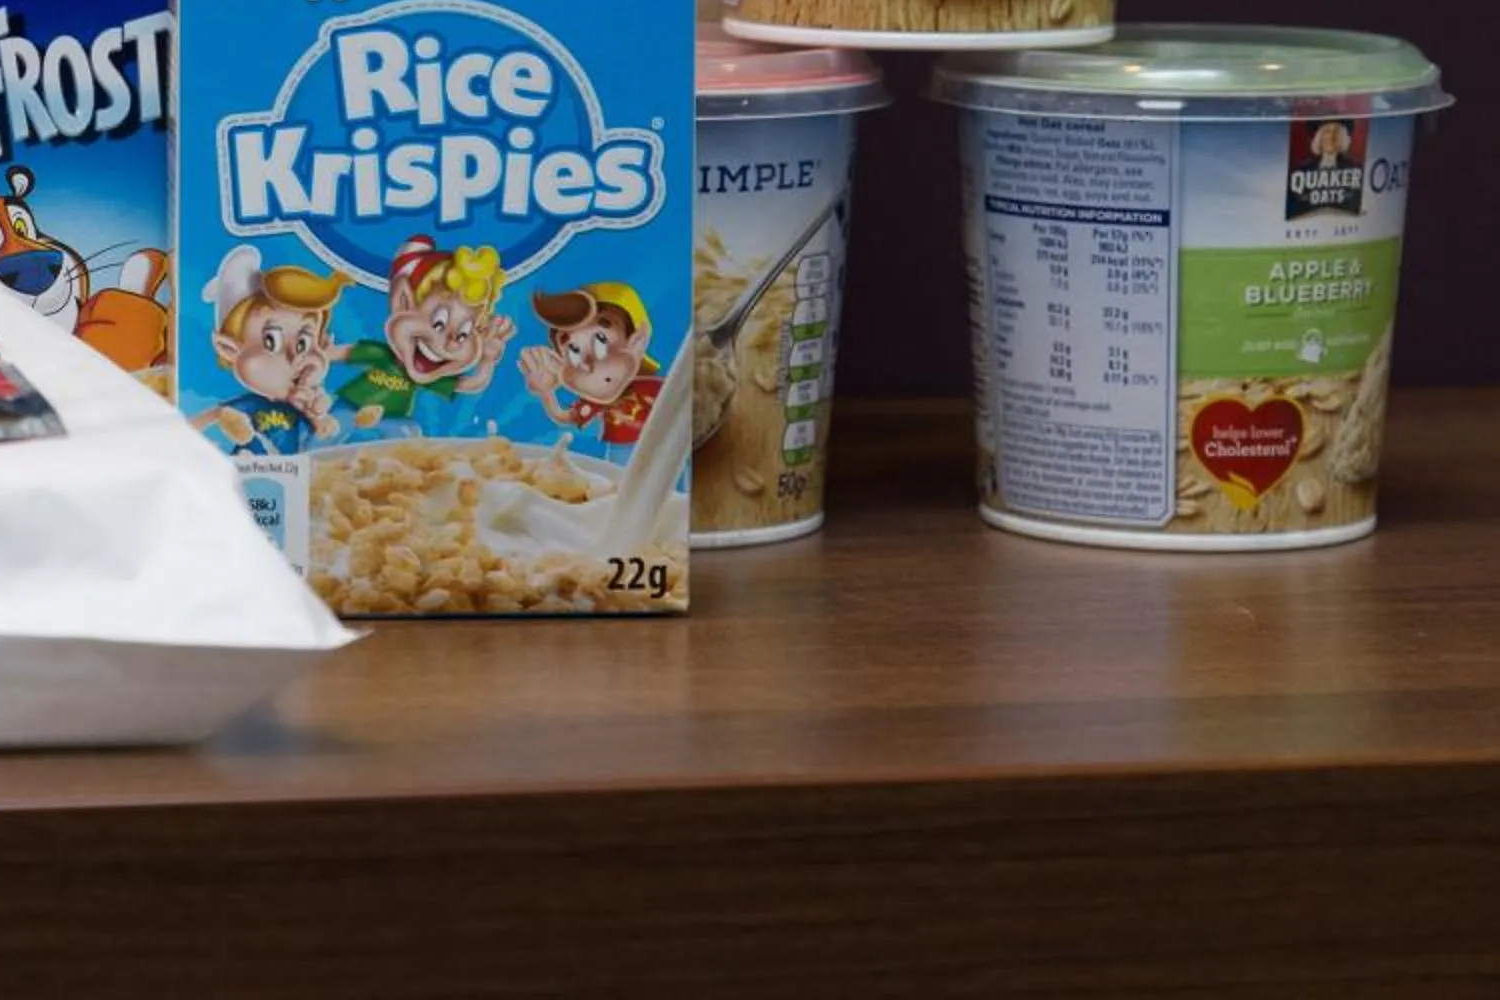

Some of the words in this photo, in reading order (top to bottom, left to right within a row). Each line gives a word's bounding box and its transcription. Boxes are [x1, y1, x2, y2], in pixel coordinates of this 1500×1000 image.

[336, 30, 553, 126] Rice
[235, 126, 647, 224] Krispies
[1291, 168, 1364, 195] QUAKER
[1310, 189, 1346, 205] OATS
[1078, 207, 1163, 224] INFORMATION
[1269, 258, 1346, 281] APPLE
[1349, 257, 1363, 275] &
[1245, 279, 1372, 305] BLUEBERRY
[1212, 424, 1248, 444] helps
[1250, 424, 1285, 440] lower
[778, 472, 807, 499] 50g
[607, 557, 668, 597] 22g
